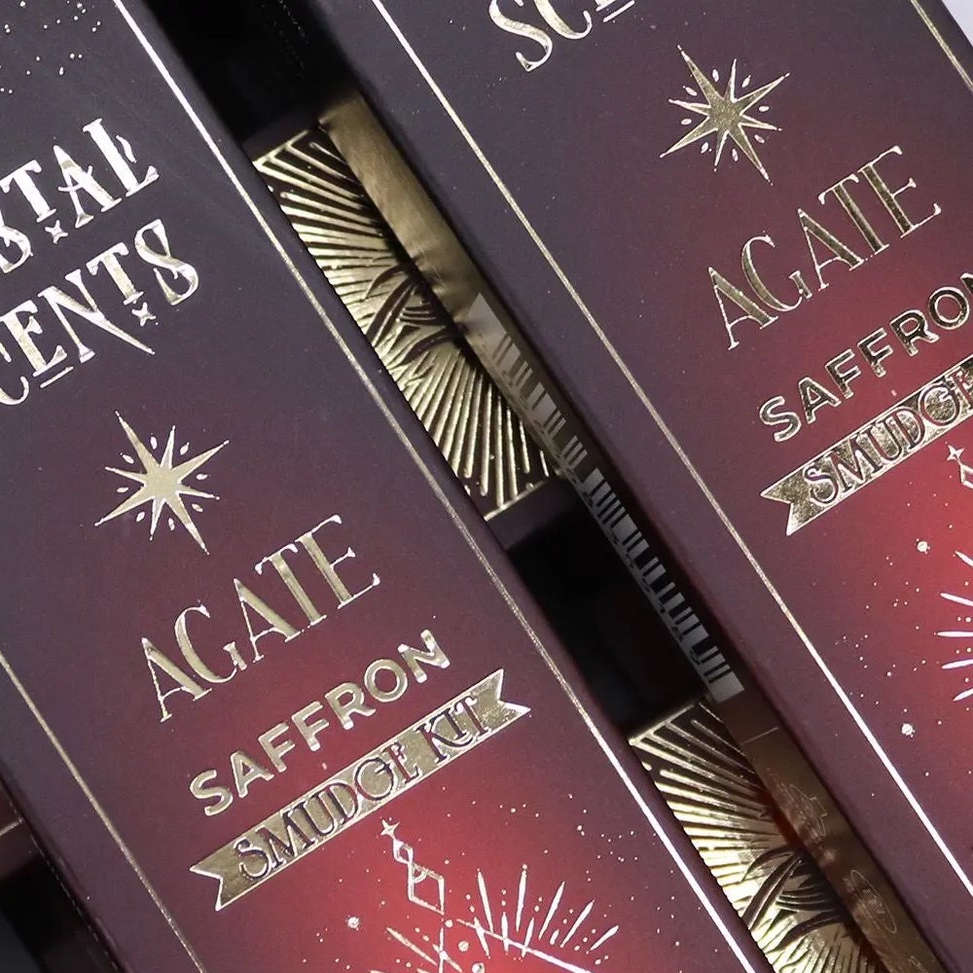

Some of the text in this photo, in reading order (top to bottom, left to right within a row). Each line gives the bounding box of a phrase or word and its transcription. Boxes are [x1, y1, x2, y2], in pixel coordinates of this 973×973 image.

[708, 145, 942, 350] AGATE
[141, 514, 380, 722] AGATE
[190, 629, 450, 817] SAFFRON
[234, 694, 493, 880] SMUDGE KIT
